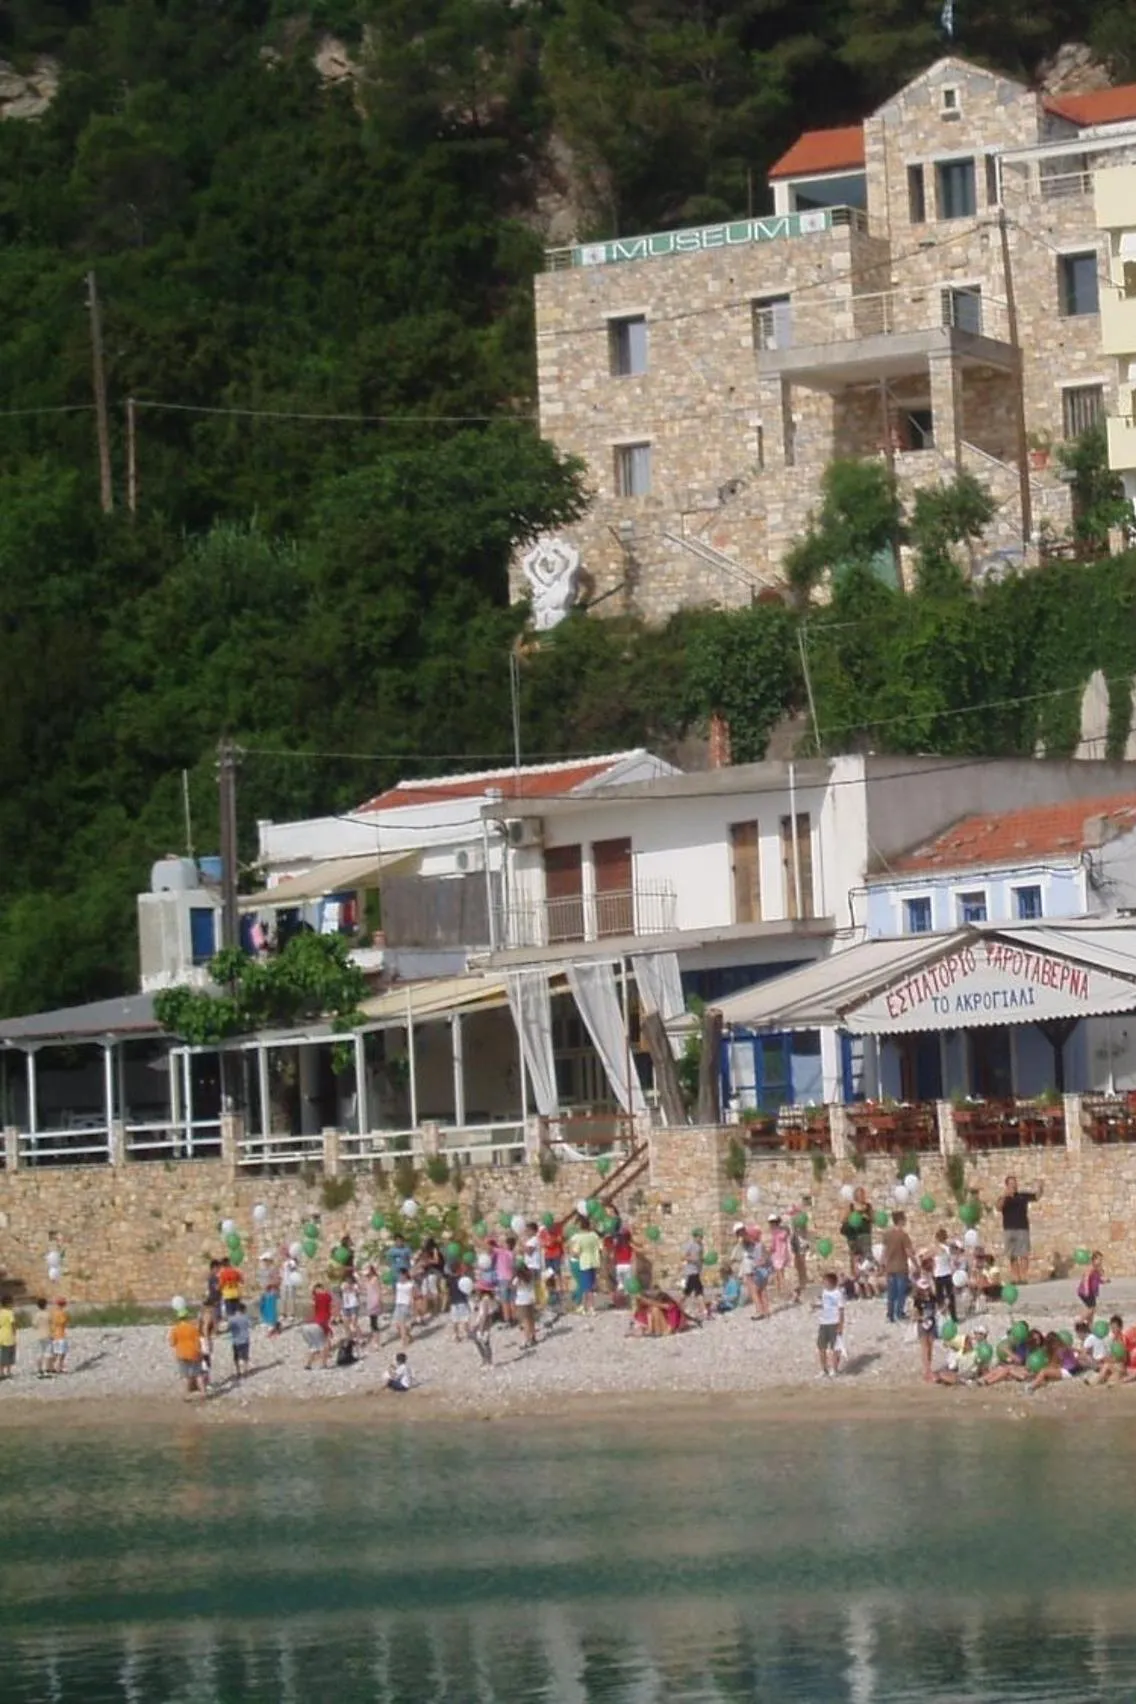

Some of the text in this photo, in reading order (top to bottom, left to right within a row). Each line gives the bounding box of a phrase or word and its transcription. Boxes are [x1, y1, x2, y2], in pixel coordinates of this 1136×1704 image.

[612, 217, 791, 260] MUSEUM
[886, 949, 977, 1019] ΕΣΤΙΑΤΟΡΙΟ
[932, 987, 1036, 1014] ΤΟ ΑΚΡΟΓΙΑΛΙ
